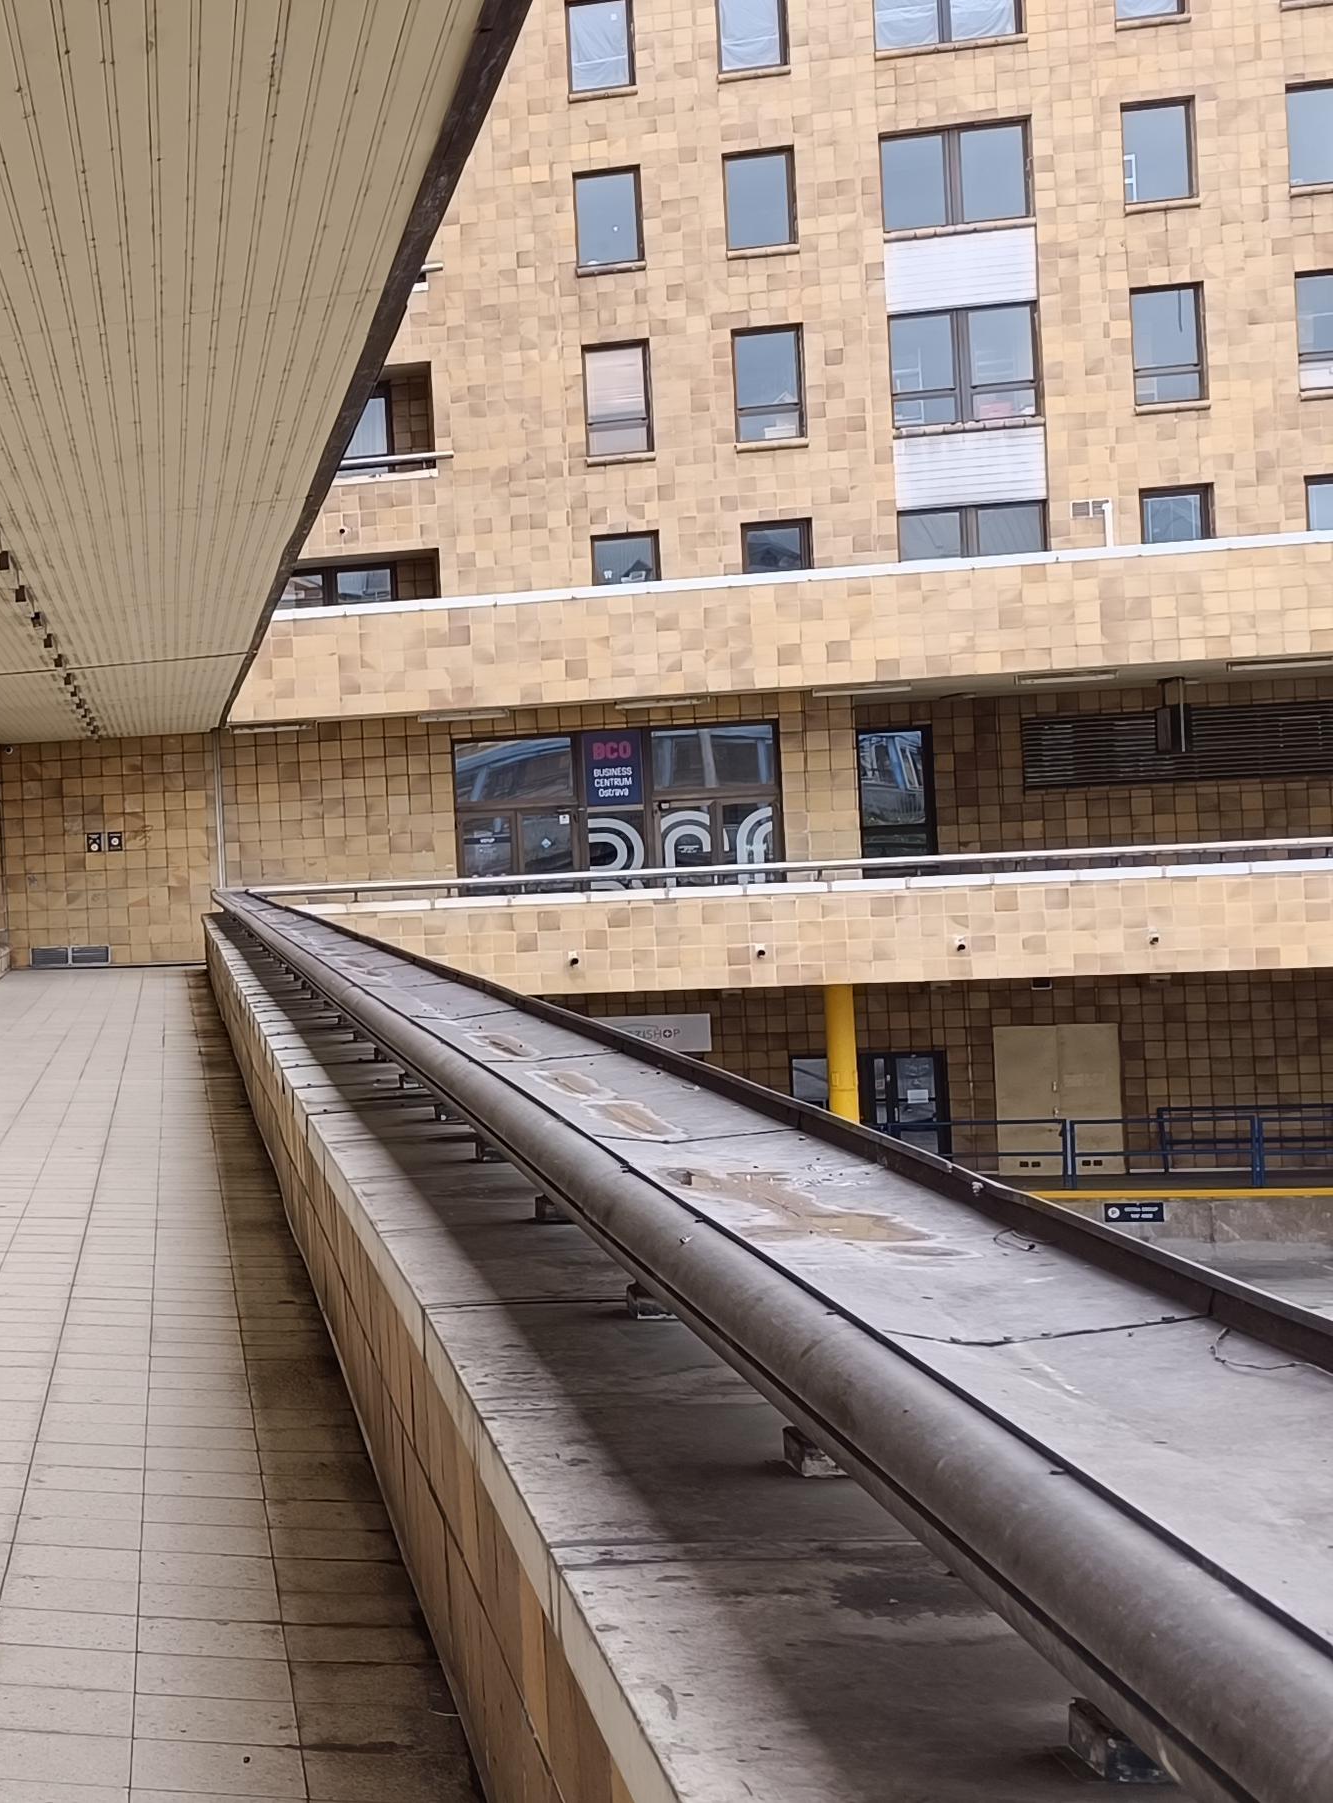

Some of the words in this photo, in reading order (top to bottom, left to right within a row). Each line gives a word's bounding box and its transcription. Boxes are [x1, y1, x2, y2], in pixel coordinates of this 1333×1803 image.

[592, 741, 632, 760] BCO
[593, 766, 633, 778] BUSINESS
[594, 777, 633, 788] CENTRUM
[598, 787, 630, 798] Ostrava
